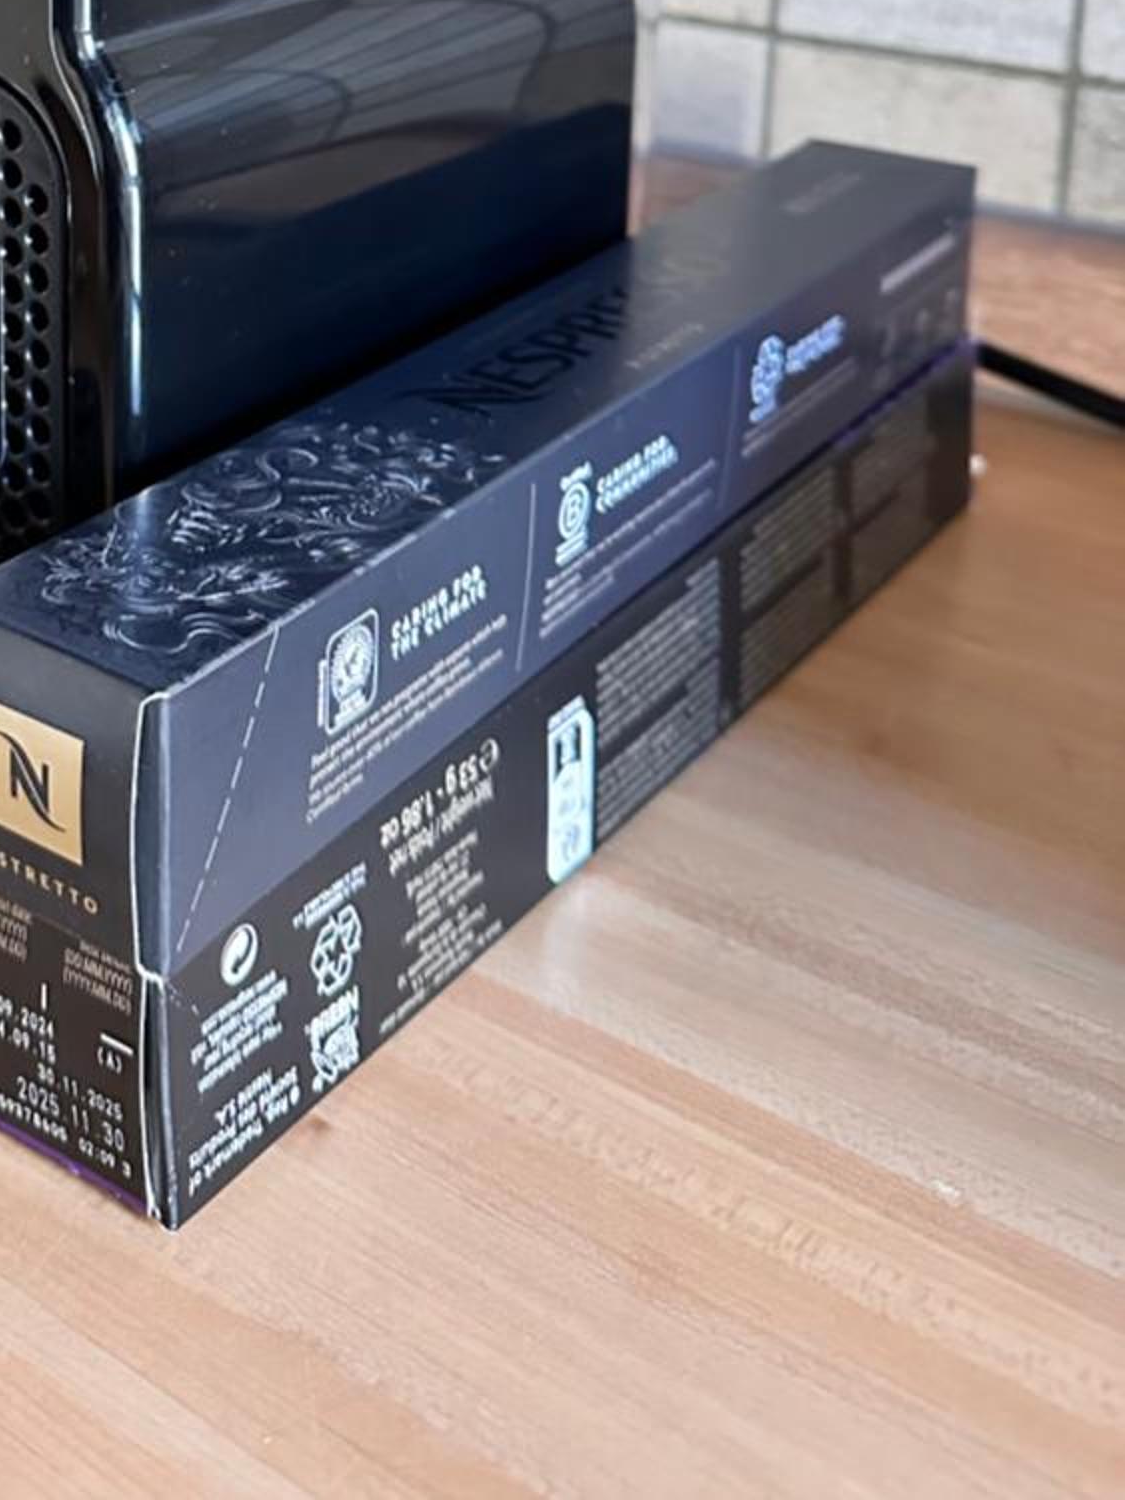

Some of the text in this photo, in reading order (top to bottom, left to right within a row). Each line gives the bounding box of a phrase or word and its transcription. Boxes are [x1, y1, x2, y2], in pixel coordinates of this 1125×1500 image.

[391, 565, 481, 638] CARING FOR
[424, 578, 486, 637] CLIMATE
[16, 1075, 125, 1151] 2025.11.30
[36, 1062, 124, 1122] 30.11.2025
